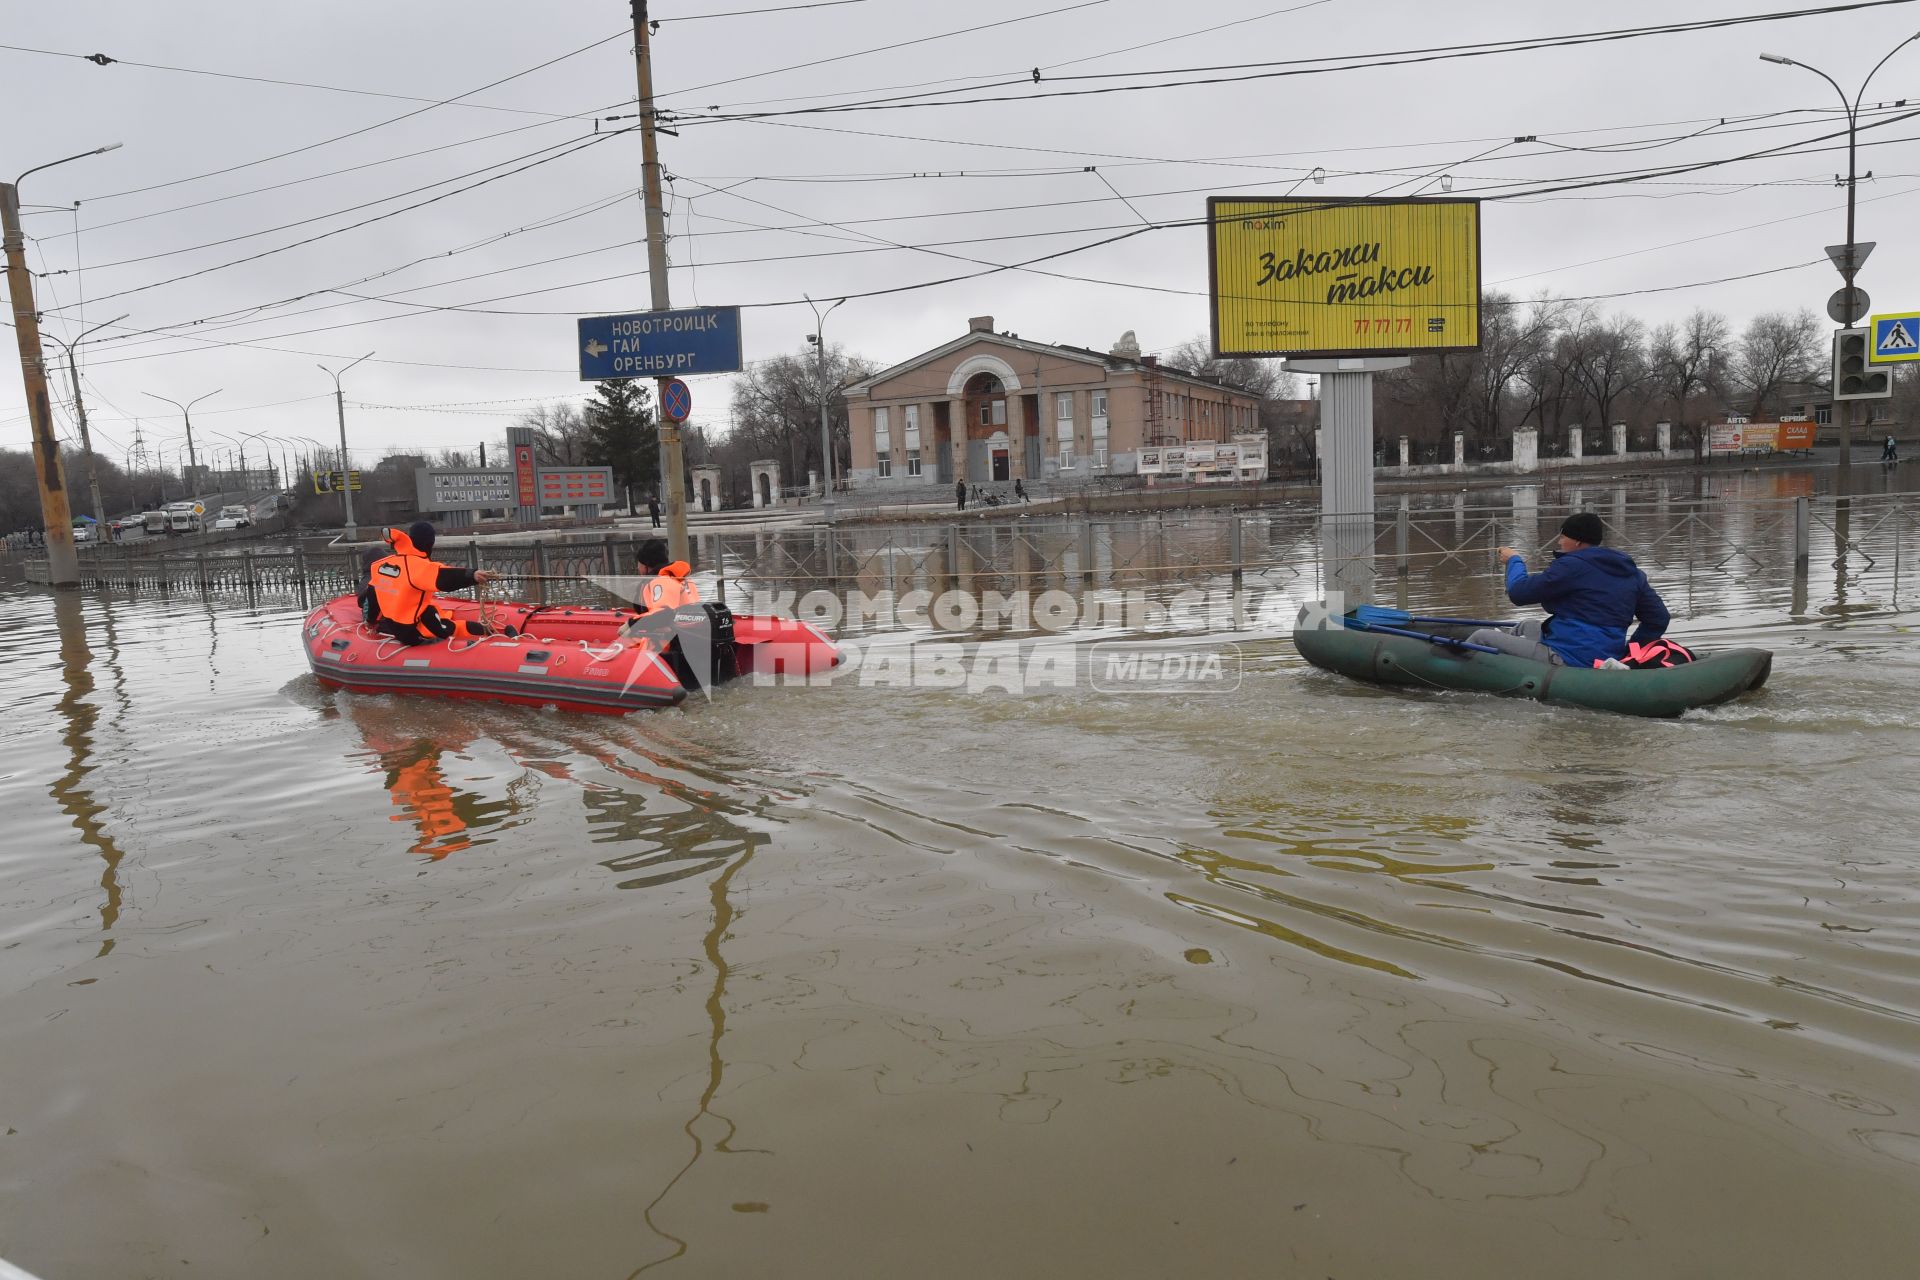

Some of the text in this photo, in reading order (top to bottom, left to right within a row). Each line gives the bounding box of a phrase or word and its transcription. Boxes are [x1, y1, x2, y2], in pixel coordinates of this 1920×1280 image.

[1243, 218, 1285, 230] maxim
[1257, 242, 1380, 286] Закажи
[1326, 265, 1434, 305] такси
[1354, 318, 1412, 334] 77 77 77
[613, 336, 640, 353] ГАЙ
[614, 353, 696, 372] ОРЕНБУРГ
[674, 614, 706, 622] MERCURY
